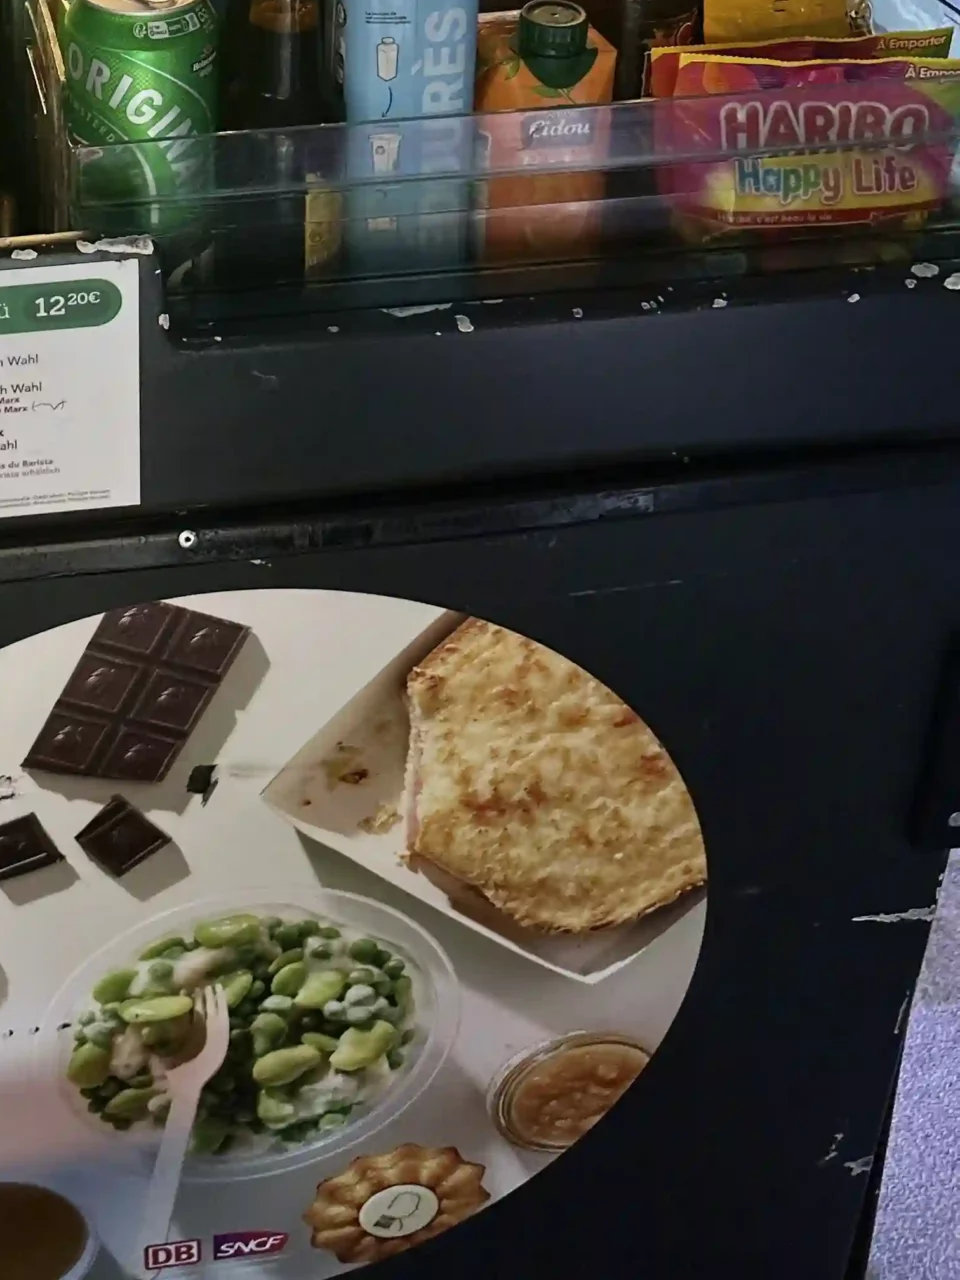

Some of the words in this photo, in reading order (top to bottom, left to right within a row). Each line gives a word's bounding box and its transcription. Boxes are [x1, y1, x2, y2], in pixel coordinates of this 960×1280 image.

[889, 36, 947, 50] Emporter
[719, 101, 930, 153] HARIBO
[734, 157, 845, 205] Happy
[851, 153, 920, 196] Life
[7, 353, 39, 367] Wahl
[11, 381, 42, 394] Wahl
[4, 405, 29, 414] Marx
[8, 461, 20, 469] du
[22, 459, 54, 468] Barista
[150, 1243, 196, 1266] DB
[215, 1234, 285, 1258] SNCF
